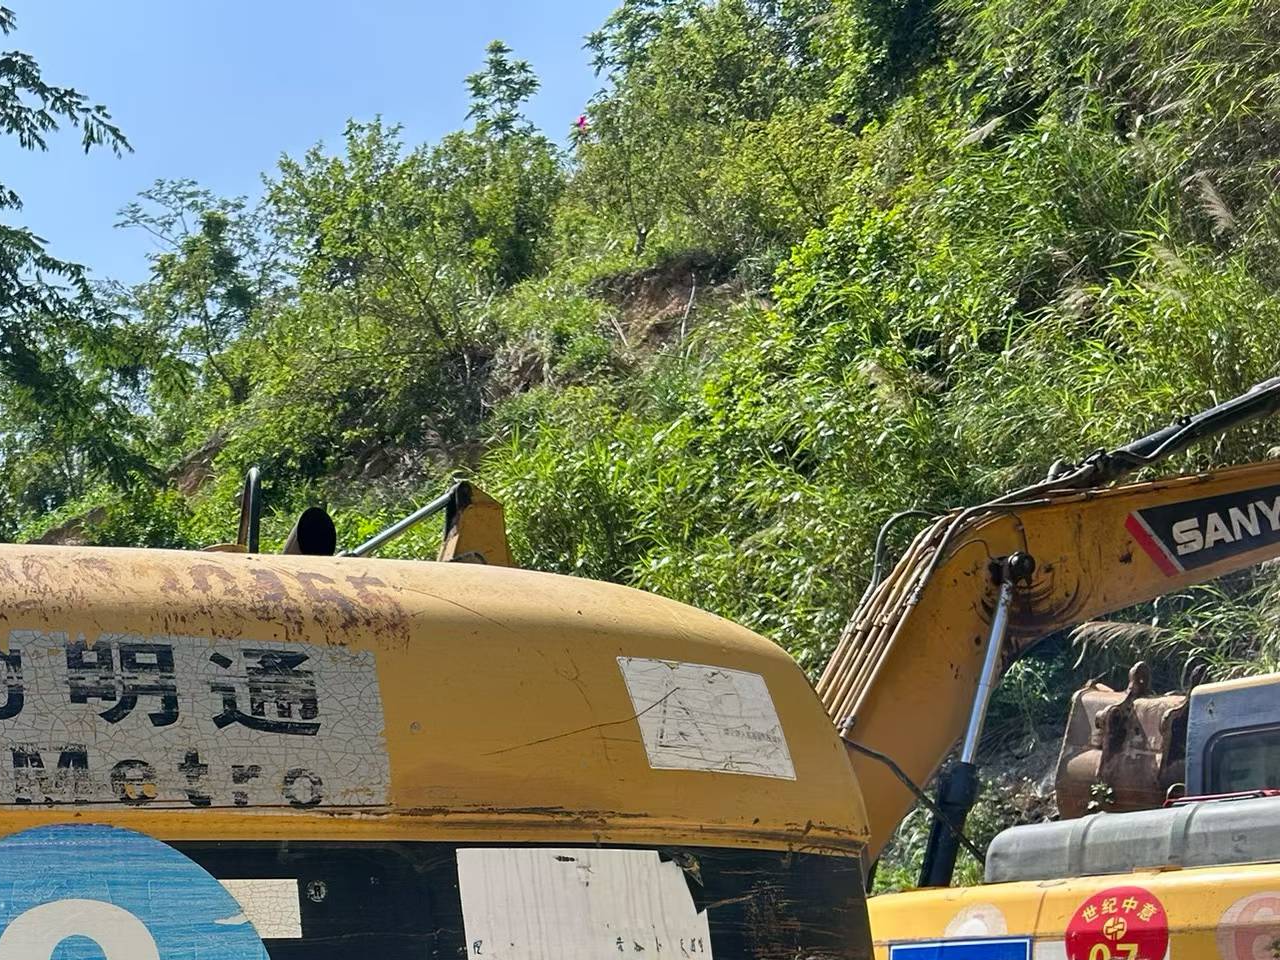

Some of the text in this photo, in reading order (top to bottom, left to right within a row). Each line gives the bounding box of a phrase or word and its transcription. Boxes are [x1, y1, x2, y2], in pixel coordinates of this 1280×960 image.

[1172, 496, 1280, 556] SANY
[1081, 896, 1158, 923] 世纪中意
